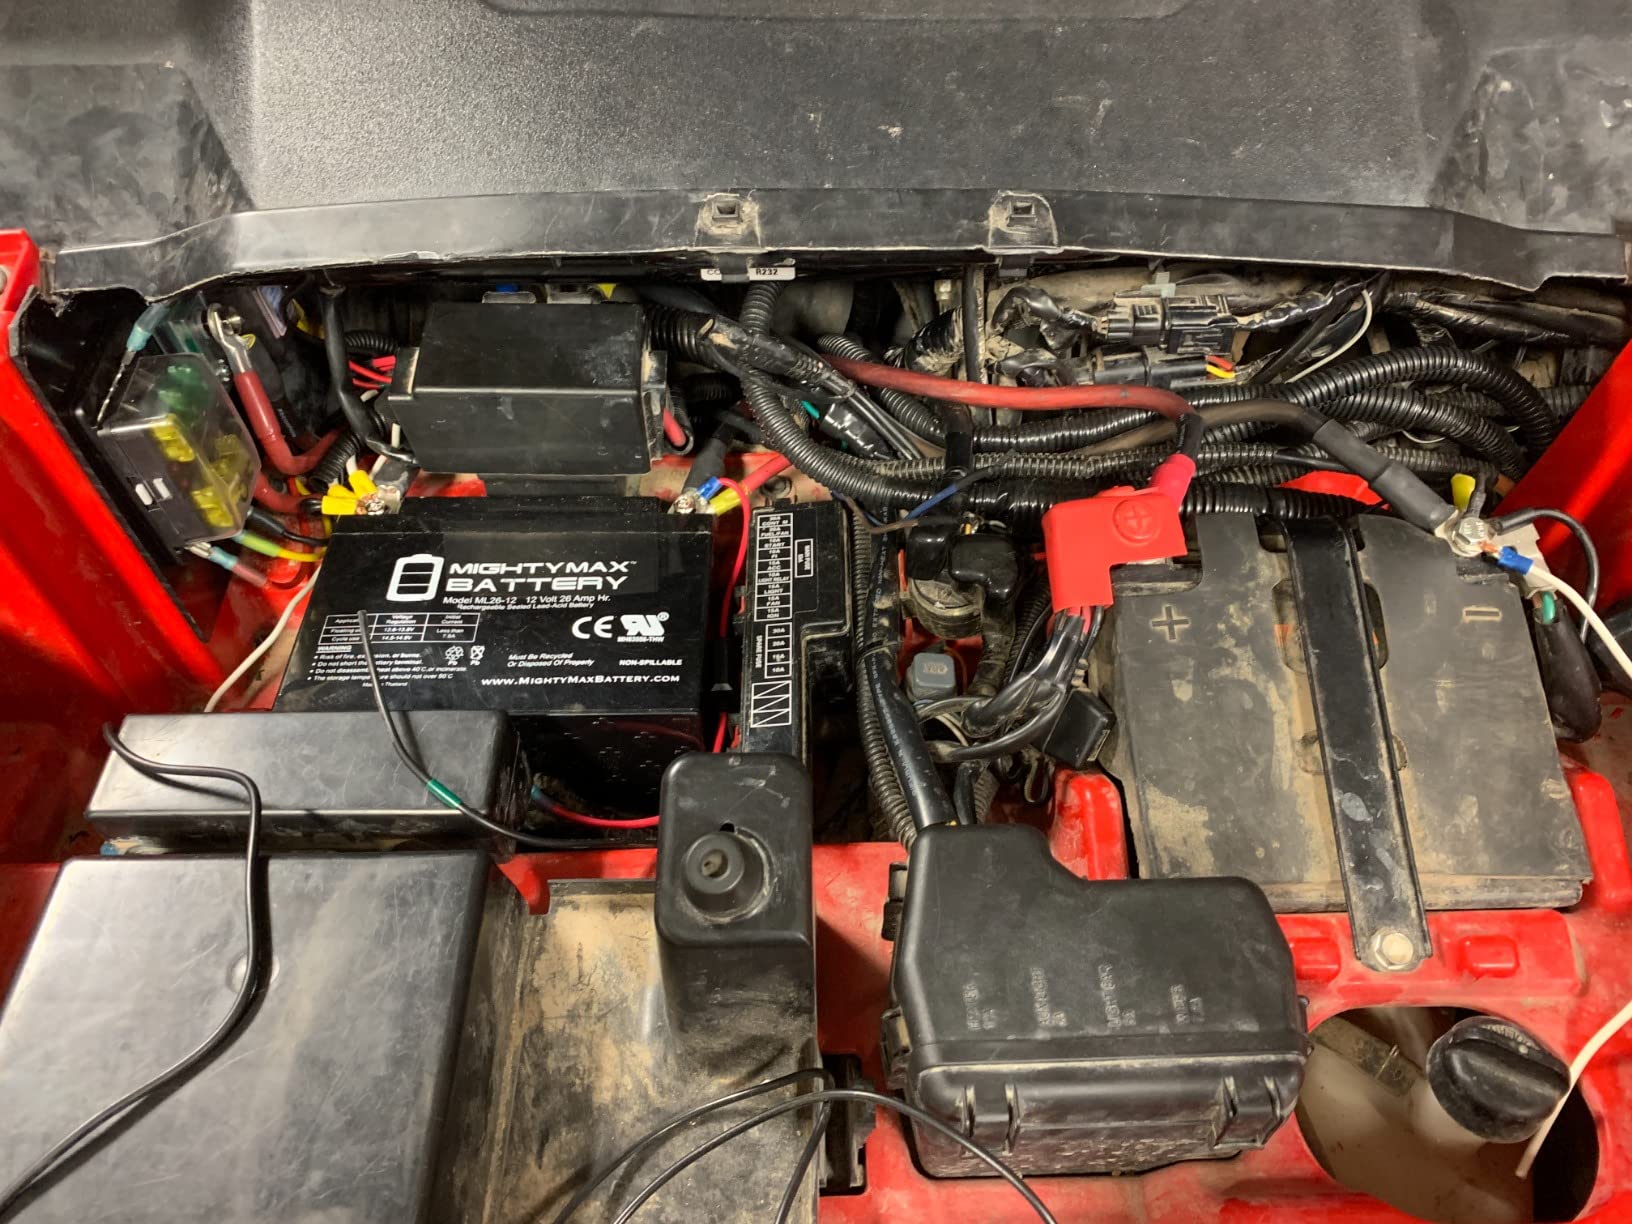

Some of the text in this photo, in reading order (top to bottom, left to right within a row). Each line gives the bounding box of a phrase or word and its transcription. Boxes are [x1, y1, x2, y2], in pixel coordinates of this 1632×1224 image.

[446, 576, 629, 592] BATTERY
[443, 596, 472, 604] Model
[474, 596, 518, 604] ML26-12
[526, 596, 537, 604] 12
[540, 595, 557, 604] Volt
[560, 595, 572, 603] 26
[574, 594, 596, 604] Amp
[569, 602, 595, 610] Battery
[540, 652, 574, 660] Recycled
[507, 660, 516, 668] Or
[518, 660, 551, 668] Disposed
